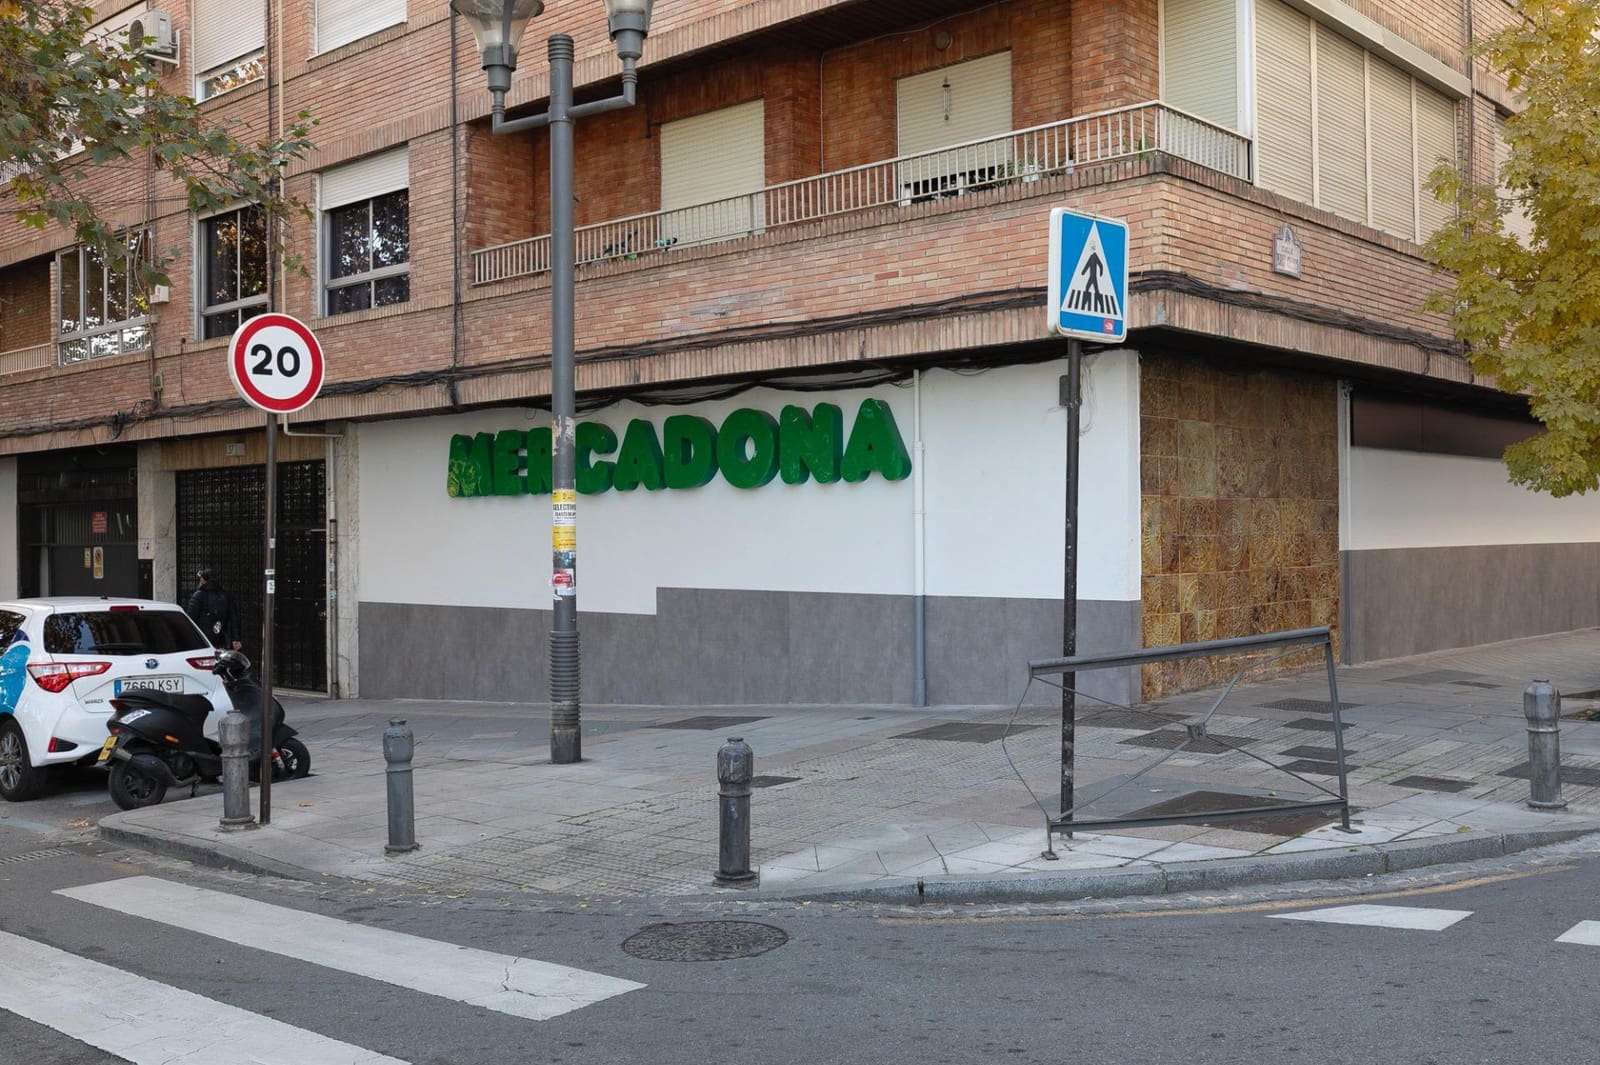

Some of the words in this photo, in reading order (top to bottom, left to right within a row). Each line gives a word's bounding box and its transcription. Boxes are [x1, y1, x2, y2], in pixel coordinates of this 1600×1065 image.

[250, 343, 301, 377] 20
[447, 398, 912, 498] MERCADONA
[158, 679, 180, 692] KSY
